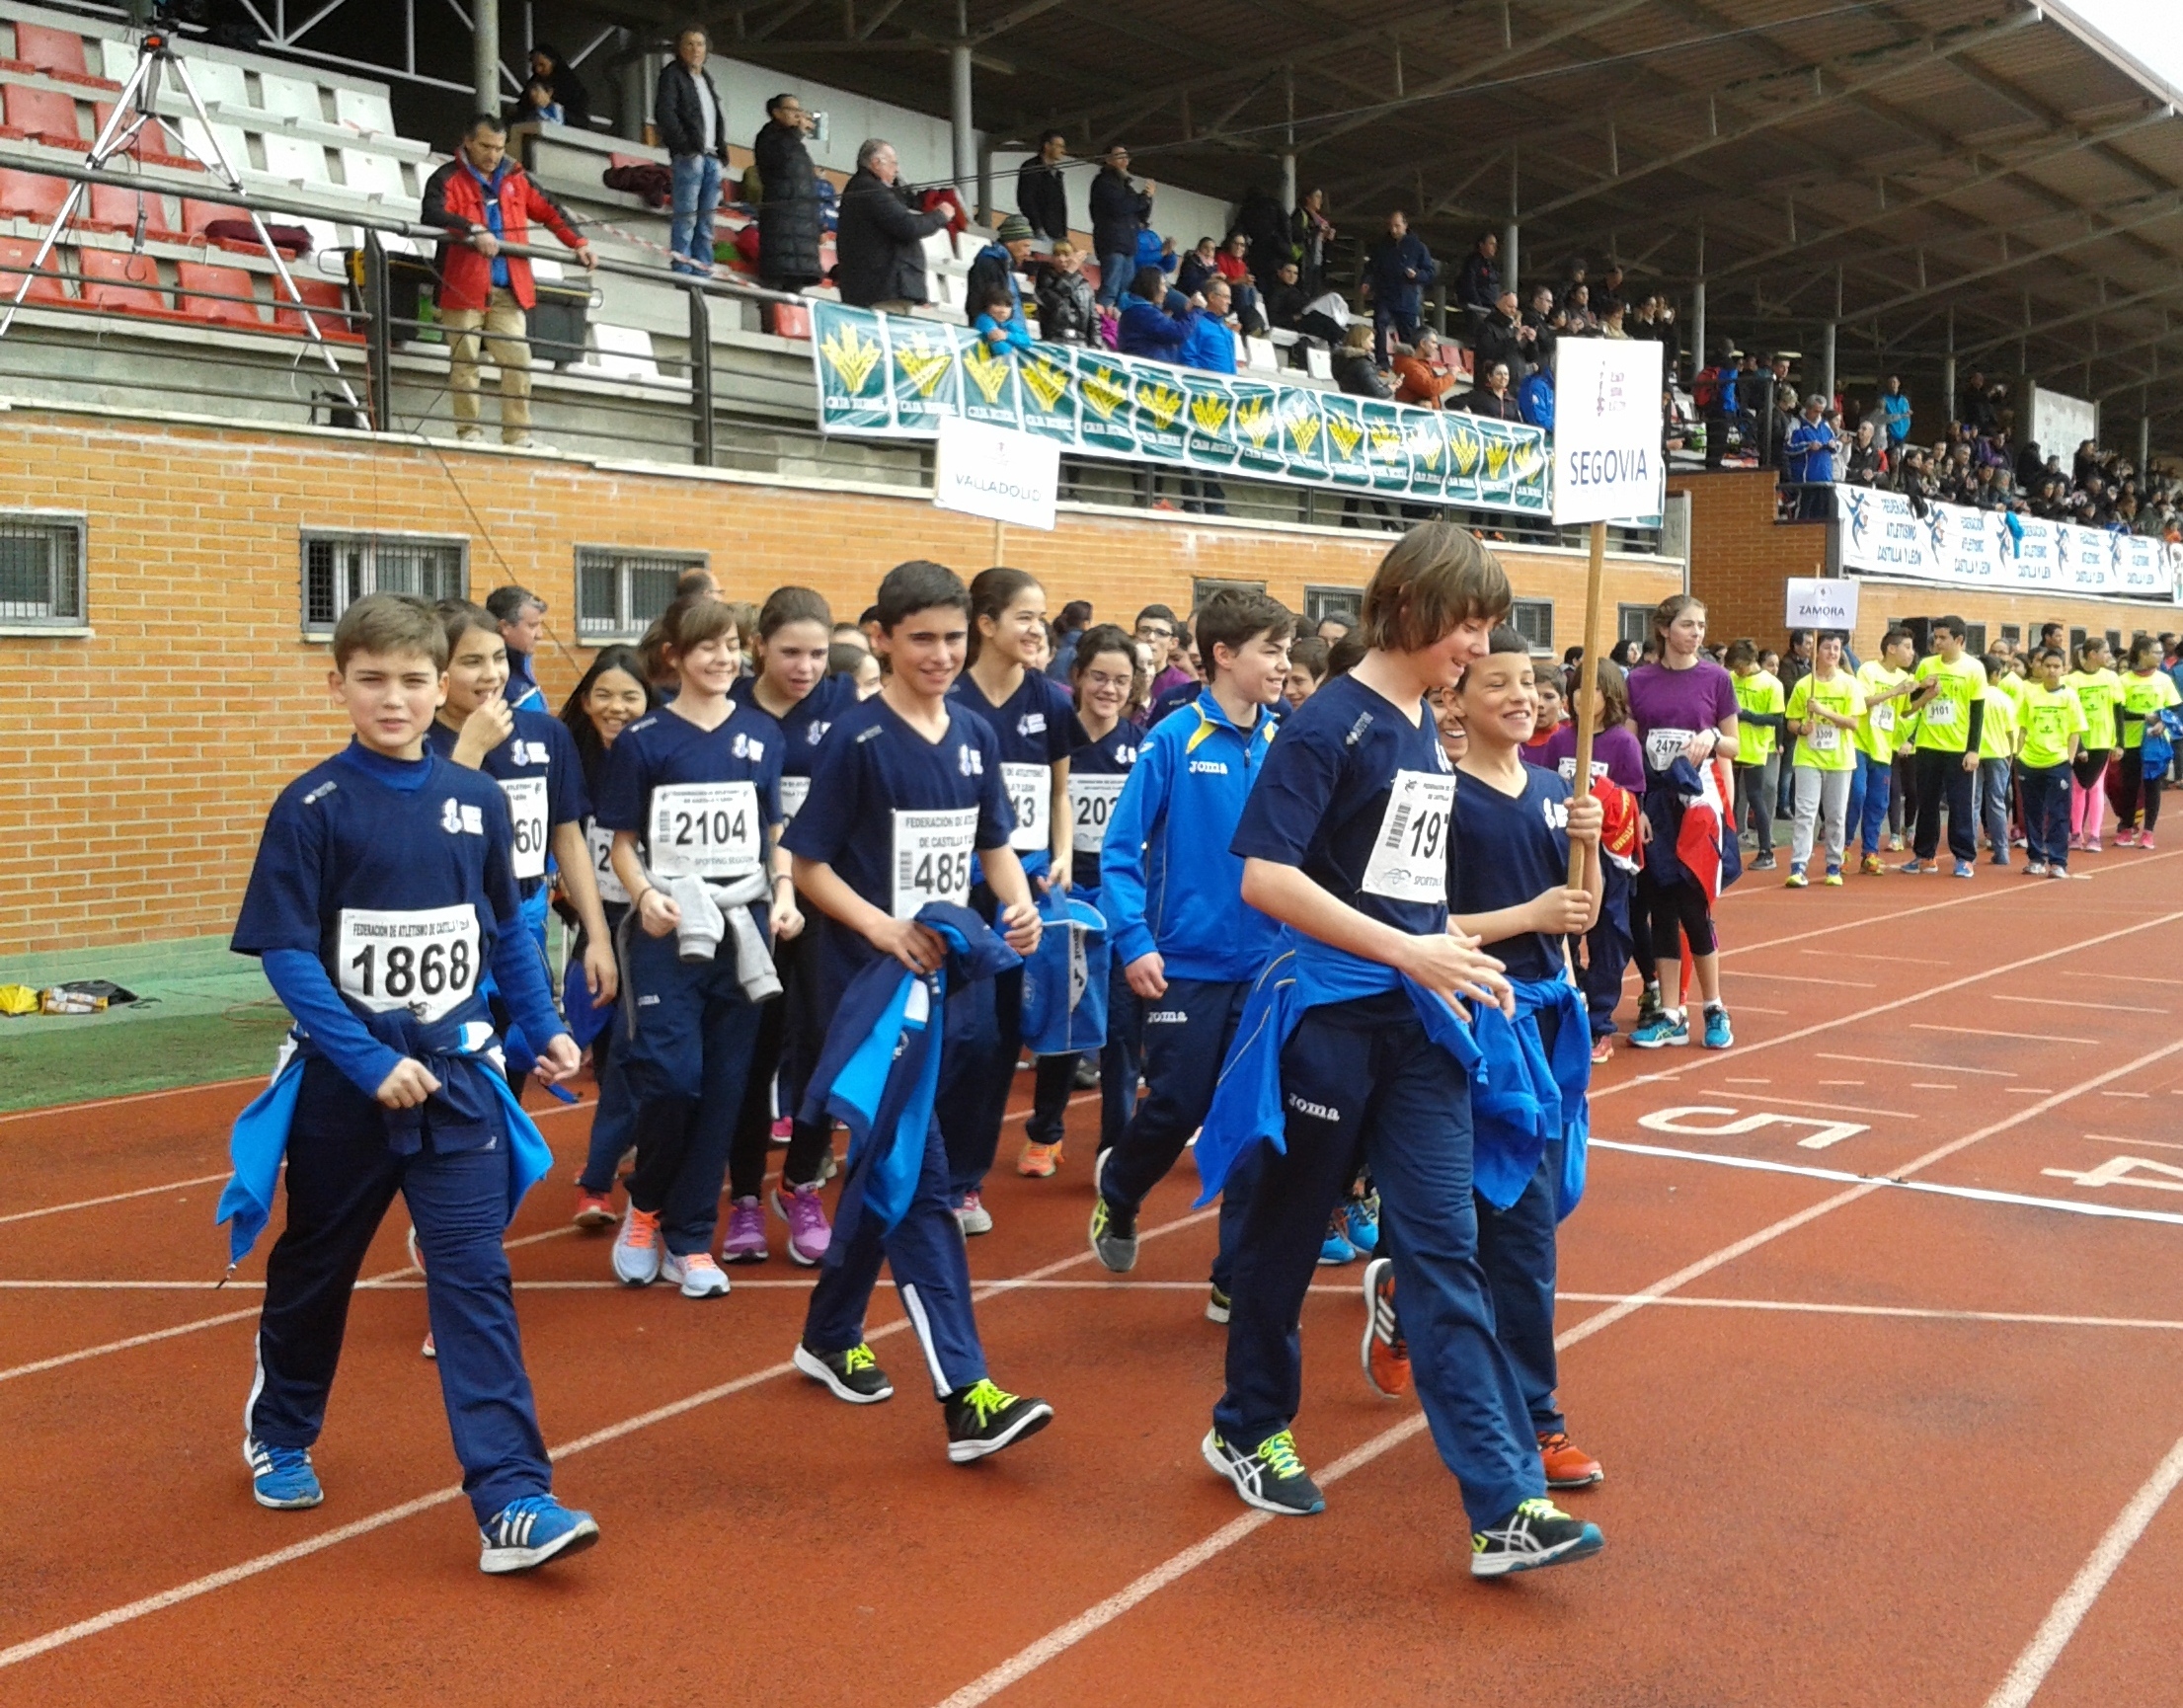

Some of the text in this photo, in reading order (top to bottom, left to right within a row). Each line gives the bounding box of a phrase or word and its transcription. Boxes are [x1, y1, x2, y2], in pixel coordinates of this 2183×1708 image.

[1570, 448, 1648, 486] SEGOVIA
[1798, 604, 1845, 617] ZAMORA
[1656, 738, 1682, 753] 2477
[675, 809, 747, 845] 2104
[914, 852, 970, 895] 485
[351, 939, 470, 997] 1868
